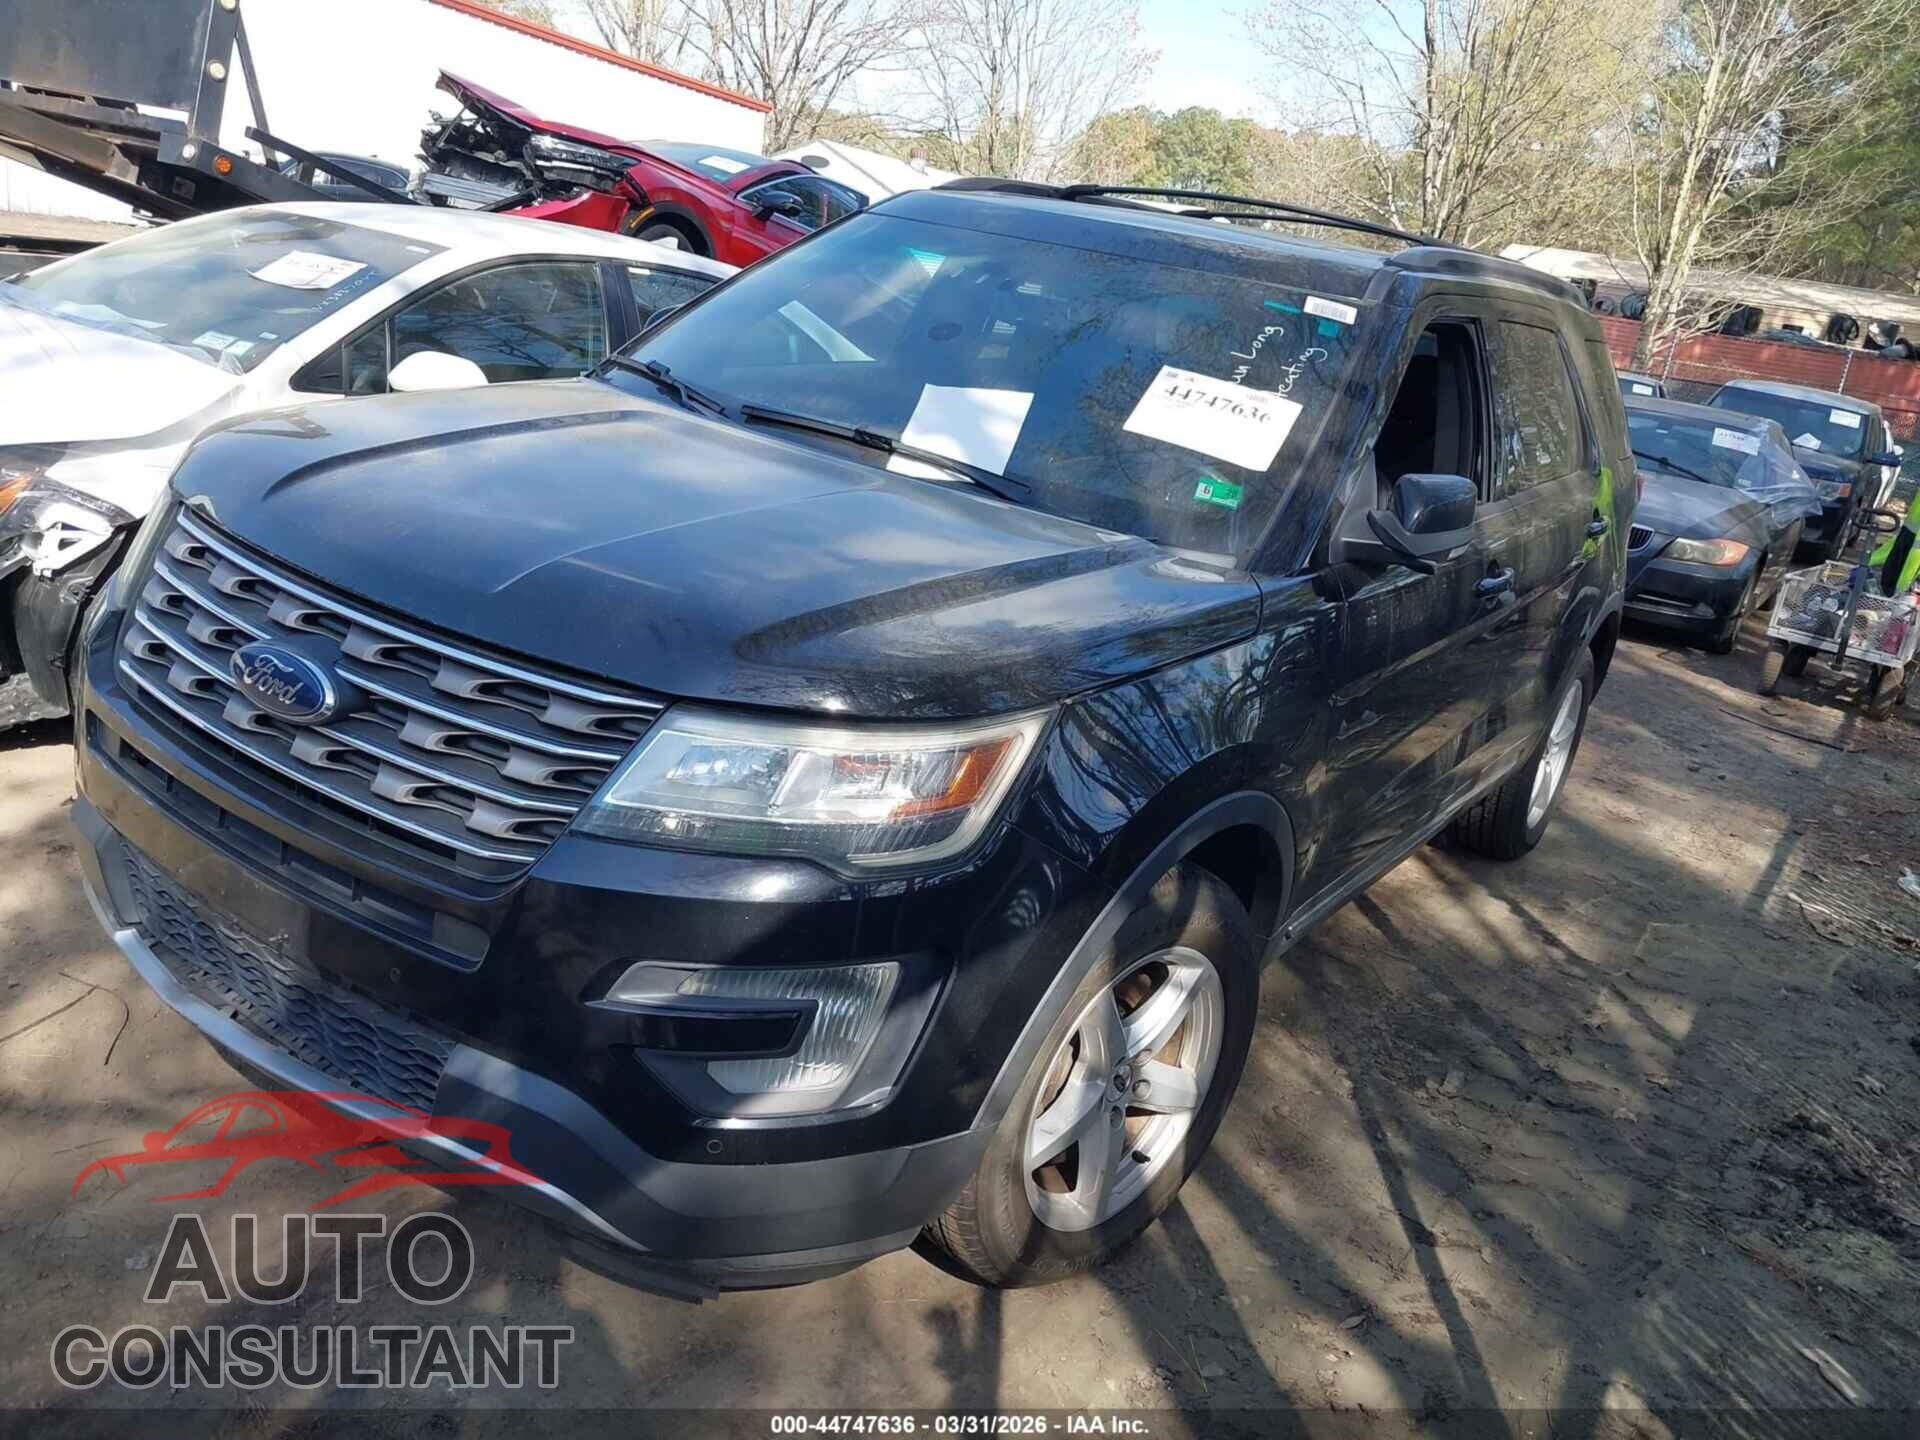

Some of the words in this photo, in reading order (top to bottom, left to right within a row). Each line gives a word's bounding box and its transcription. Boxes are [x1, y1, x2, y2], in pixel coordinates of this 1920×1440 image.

[1230, 326, 1284, 359] Long
[1164, 384, 1272, 423] 44747636
[243, 654, 304, 704] Ford
